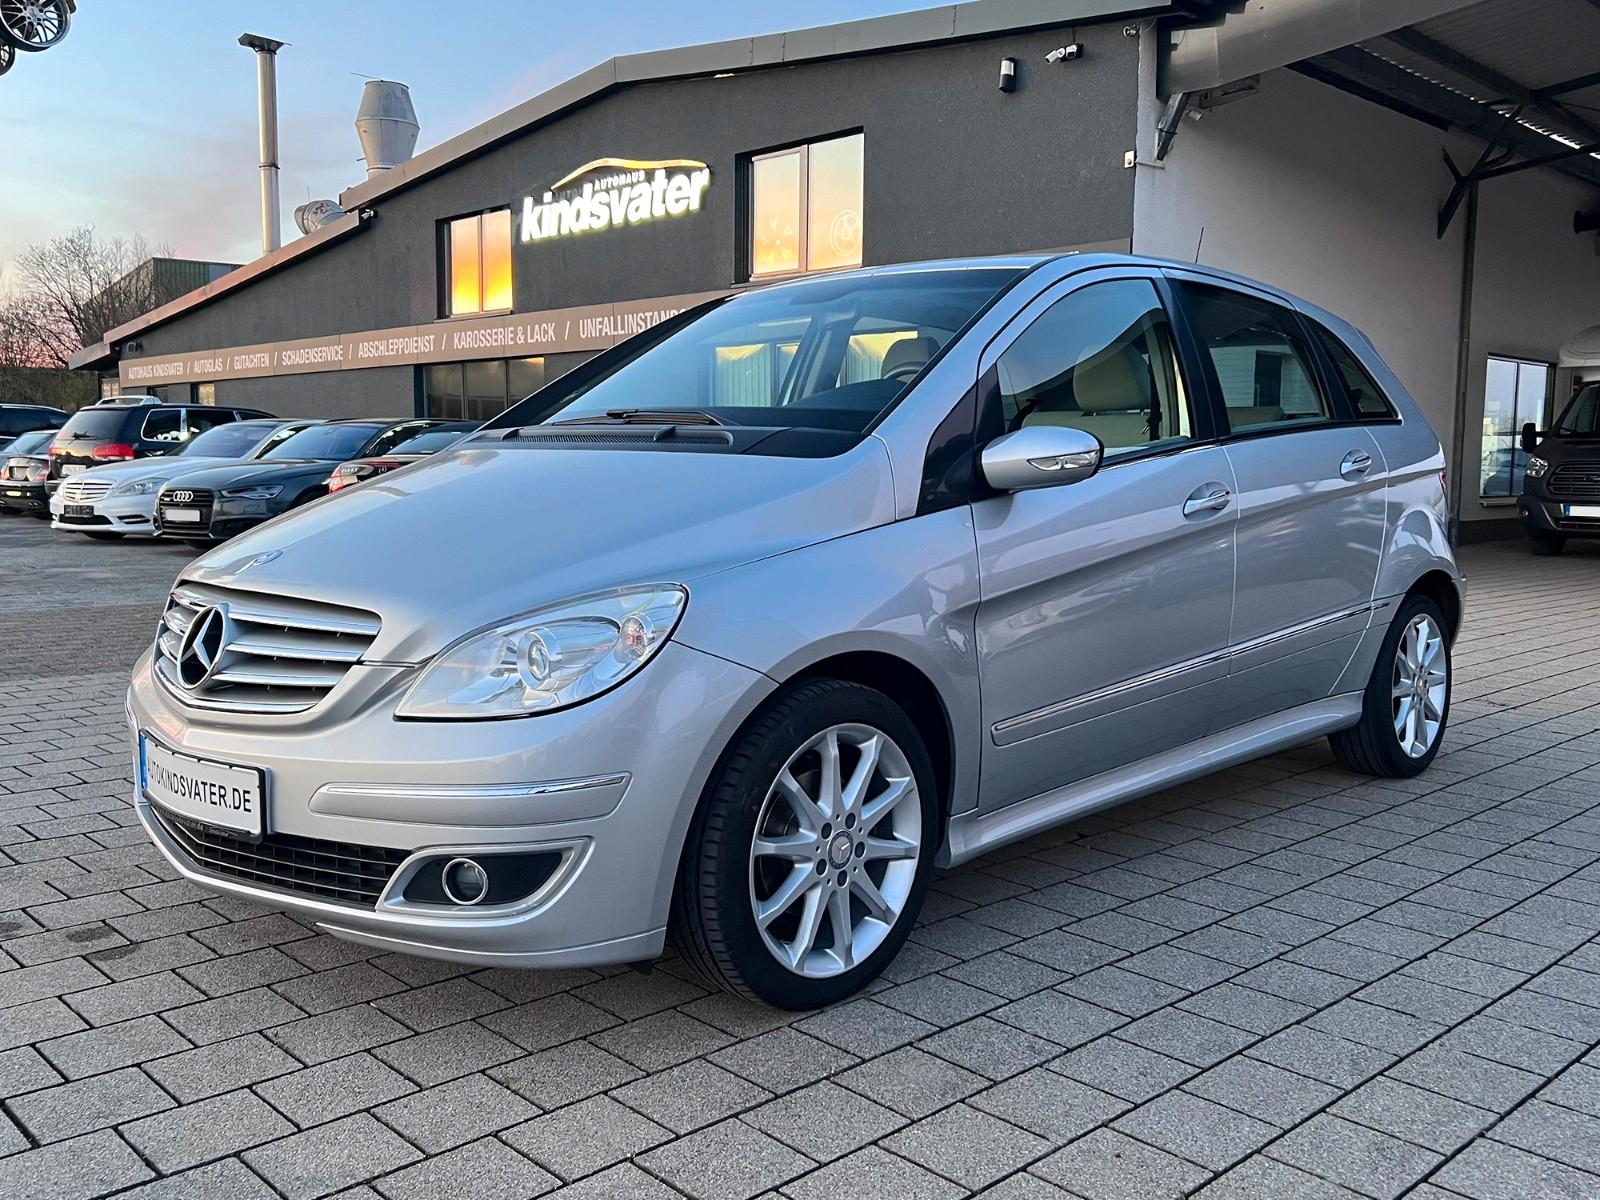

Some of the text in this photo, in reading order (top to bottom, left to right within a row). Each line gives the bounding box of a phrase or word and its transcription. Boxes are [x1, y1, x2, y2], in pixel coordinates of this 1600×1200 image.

[521, 167, 710, 242] kindsvater
[594, 169, 645, 192] AUTOHAUS
[128, 364, 153, 381] AUTOHAUS
[153, 361, 184, 377] KINDSVATER
[193, 357, 223, 374] AUTOGLAS
[234, 354, 270, 371] GUTACHTEN
[281, 344, 344, 366] SCHADENSERVICE
[358, 334, 435, 359] ABSCHLEPPDIENST
[453, 327, 514, 350] KAROSSERIE
[516, 327, 525, 344] &
[527, 322, 556, 343] LACK
[579, 308, 686, 338] UNFALLINSTAN
